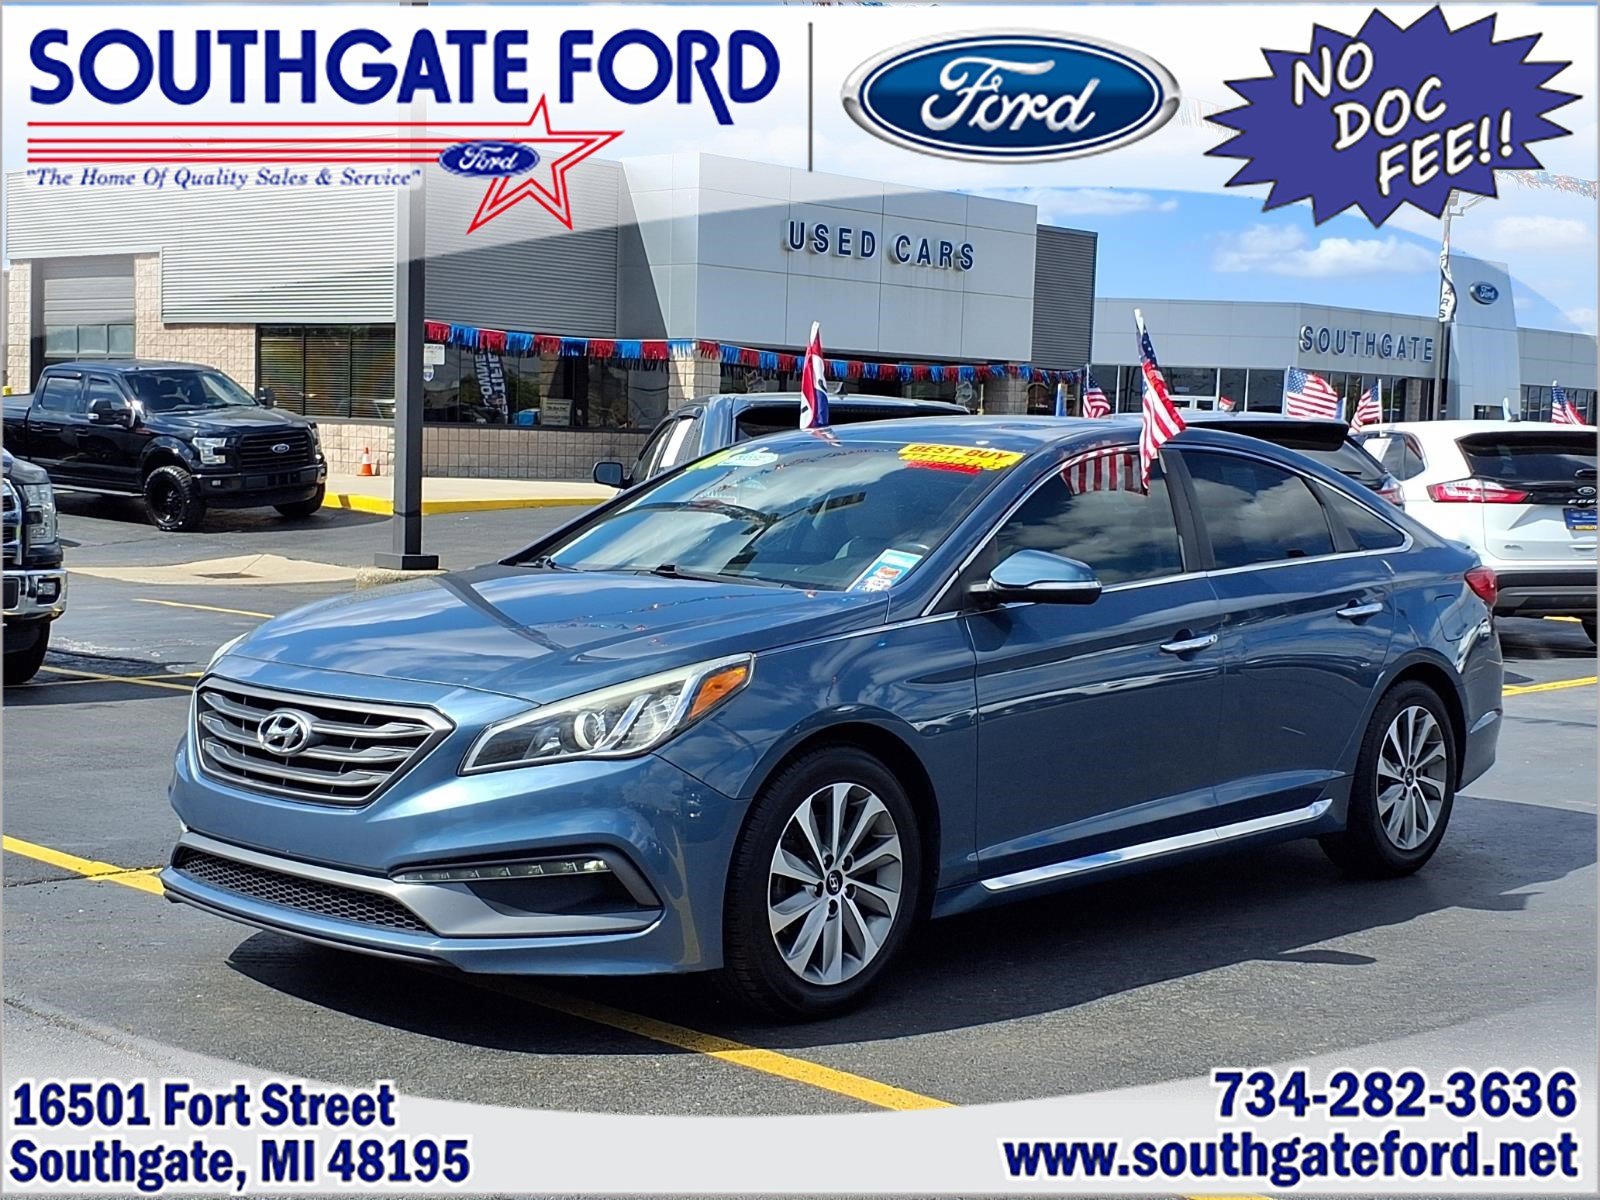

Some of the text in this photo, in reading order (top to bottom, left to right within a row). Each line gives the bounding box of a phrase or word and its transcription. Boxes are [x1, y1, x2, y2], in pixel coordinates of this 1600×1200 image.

[789, 220, 974, 271] USED CARS
[1301, 325, 1433, 361] SOUTHGATE
[908, 445, 1012, 460] BEST BUY
